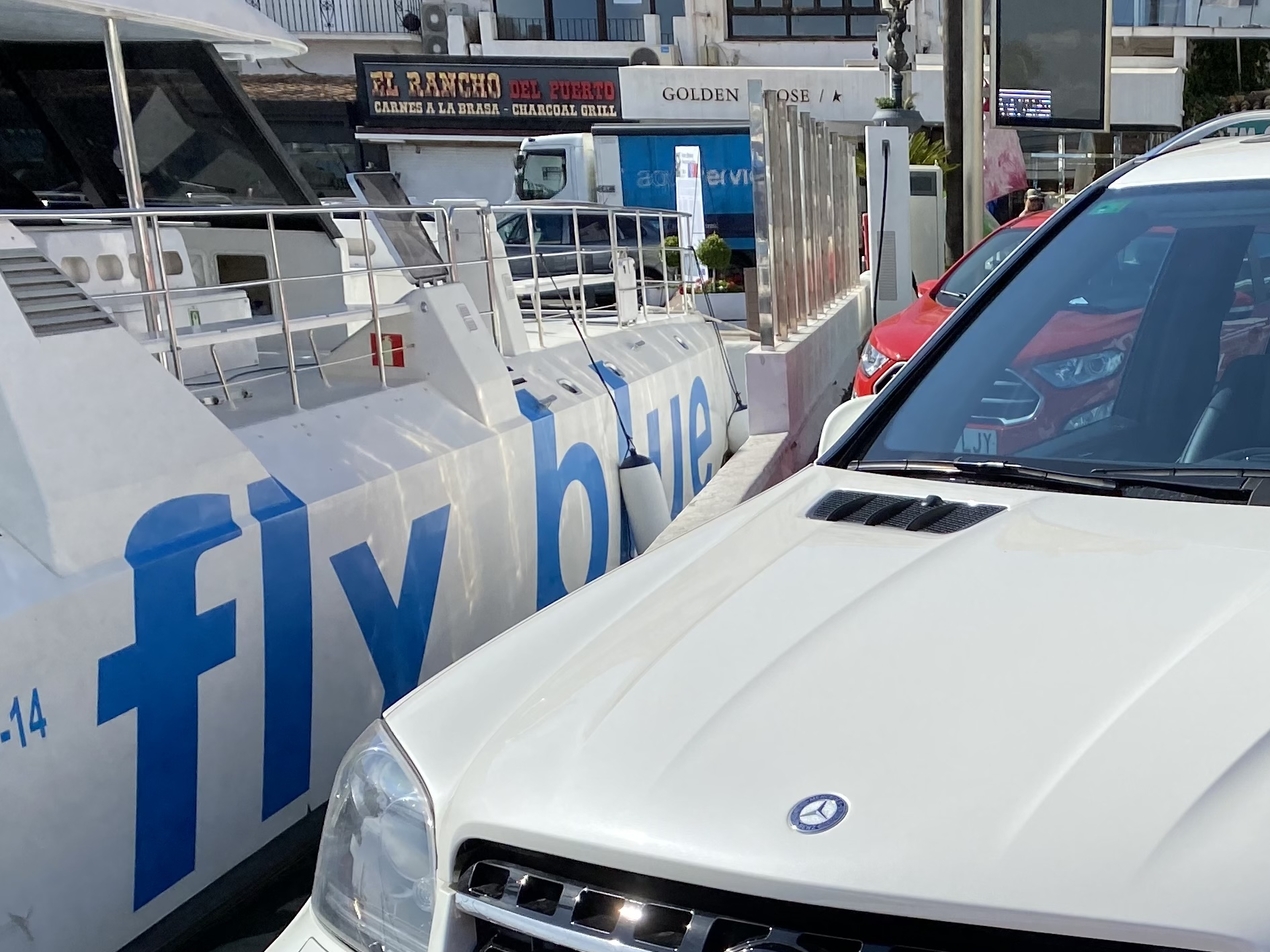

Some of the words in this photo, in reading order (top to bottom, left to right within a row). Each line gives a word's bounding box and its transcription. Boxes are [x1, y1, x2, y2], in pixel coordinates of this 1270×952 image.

[370, 71, 398, 97] EL
[406, 71, 501, 99] RANCHO
[509, 79, 541, 99] DEL
[550, 81, 615, 100] PUERTO
[662, 87, 739, 102] GOLDEN
[763, 89, 810, 102] OSE
[374, 101, 423, 114] CARNES
[425, 101, 436, 114] A
[438, 102, 457, 114] LA
[458, 102, 500, 115] BRASA
[512, 103, 578, 116] CHARCOAL
[581, 104, 617, 117] GRILL
[97, 475, 451, 912] fly
[514, 359, 713, 613] blue
